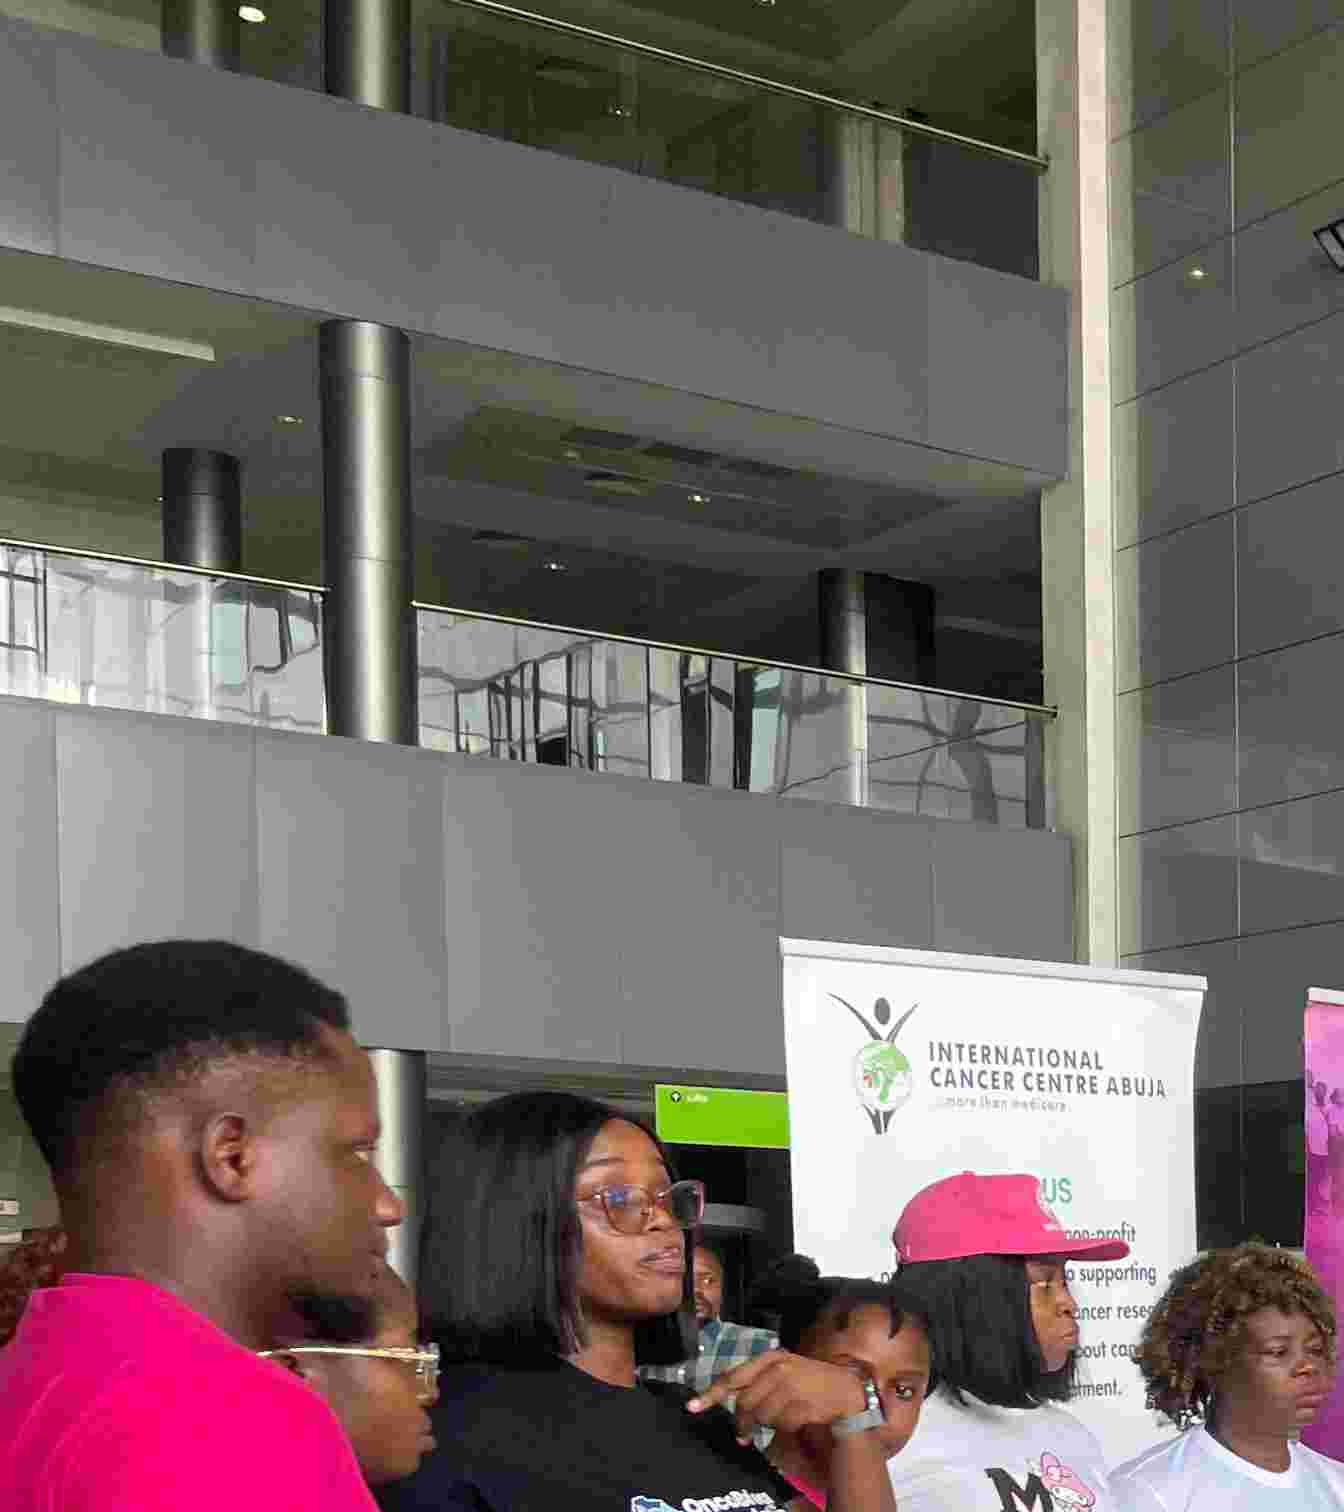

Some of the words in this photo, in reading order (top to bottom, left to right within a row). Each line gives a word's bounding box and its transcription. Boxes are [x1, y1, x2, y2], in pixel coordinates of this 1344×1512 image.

[929, 1041, 1103, 1070] INTERNATIONAL
[930, 1067, 1014, 1091] CANCER
[1023, 1072, 1099, 1094] CENTRE
[1106, 1076, 1167, 1097] ABUJA
[1080, 1263, 1157, 1286] supporting
[1073, 1307, 1112, 1321] ancer
